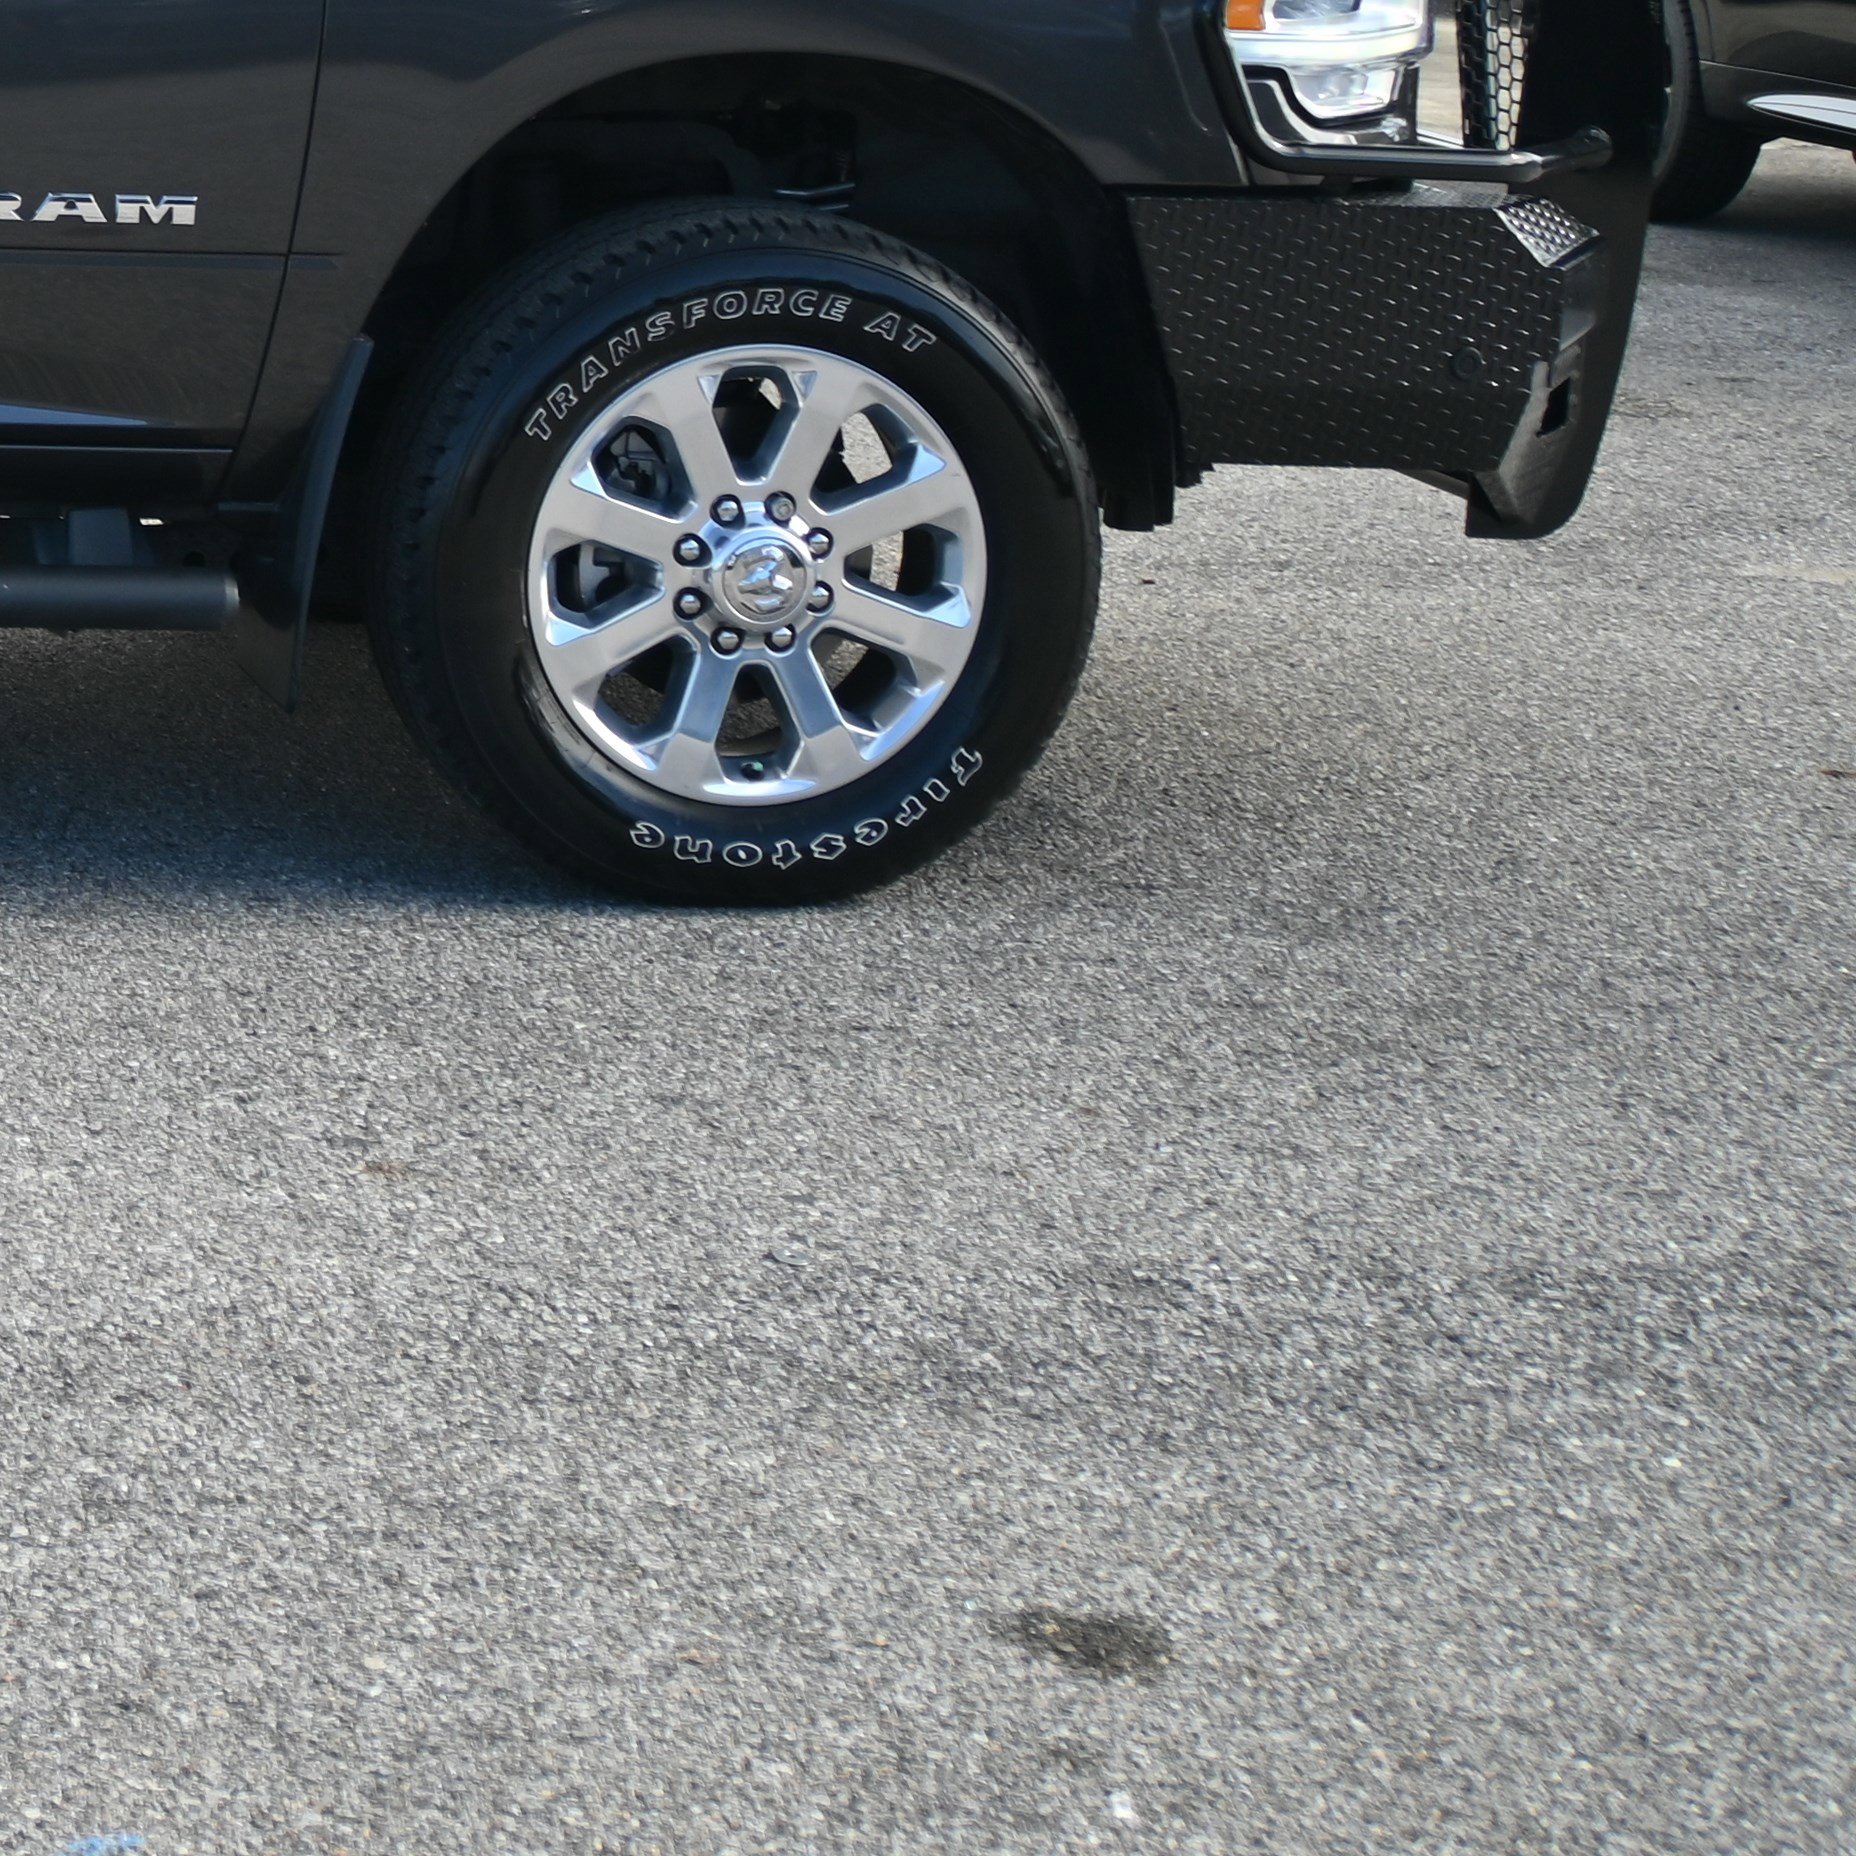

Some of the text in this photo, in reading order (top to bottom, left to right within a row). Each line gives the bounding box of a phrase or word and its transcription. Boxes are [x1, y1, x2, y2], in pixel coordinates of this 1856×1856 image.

[524, 287, 937, 443] TRANSFORCE AT
[629, 745, 984, 871] Firestone
